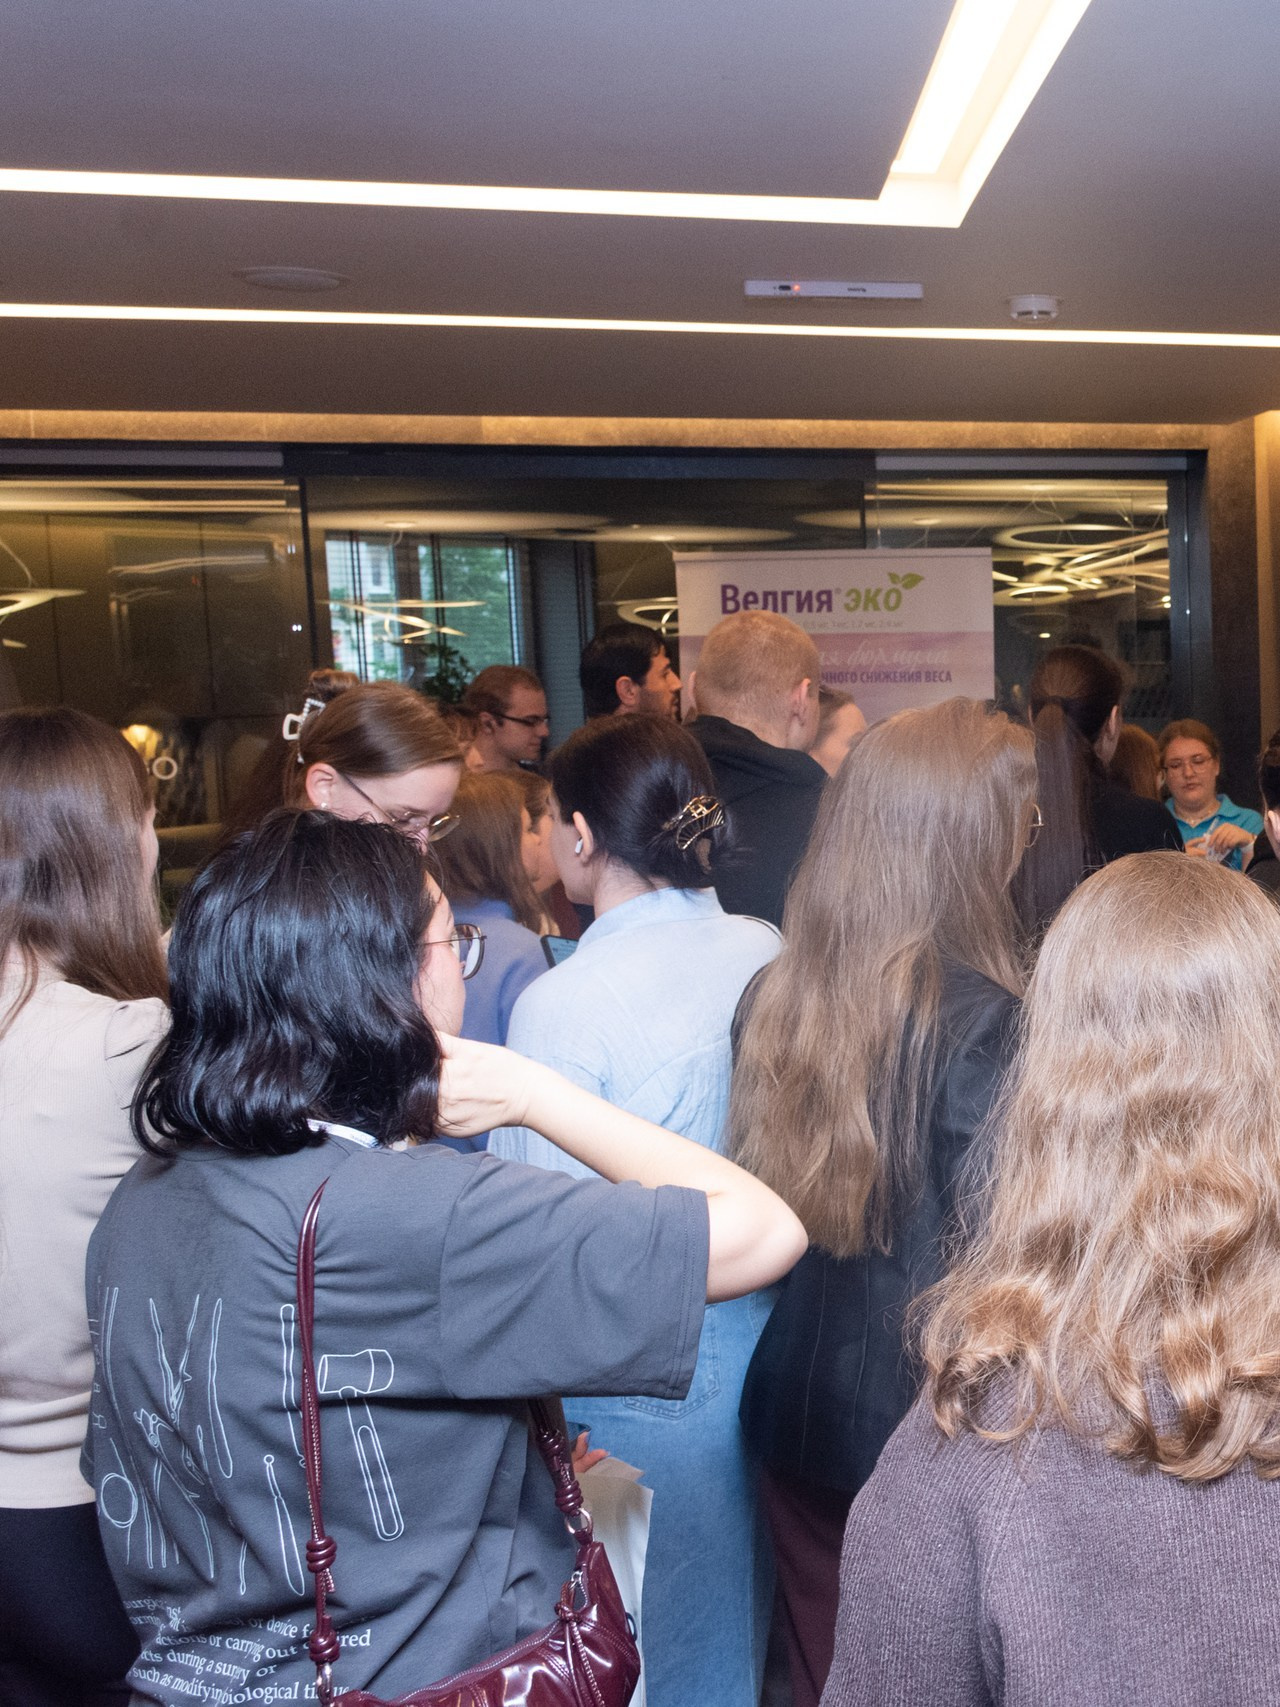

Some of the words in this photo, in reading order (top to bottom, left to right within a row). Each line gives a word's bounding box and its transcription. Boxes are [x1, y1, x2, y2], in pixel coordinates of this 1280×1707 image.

[860, 670, 922, 684] СНИЖЕНИЯ
[924, 670, 953, 683] ВЕСА
[266, 1615, 298, 1638] device
[209, 1634, 222, 1648] or
[265, 1646, 298, 1660] out
[166, 1649, 207, 1676] during
[206, 1660, 215, 1673] a
[256, 1664, 277, 1678] or
[132, 1667, 161, 1683] such
[160, 1674, 174, 1688] as
